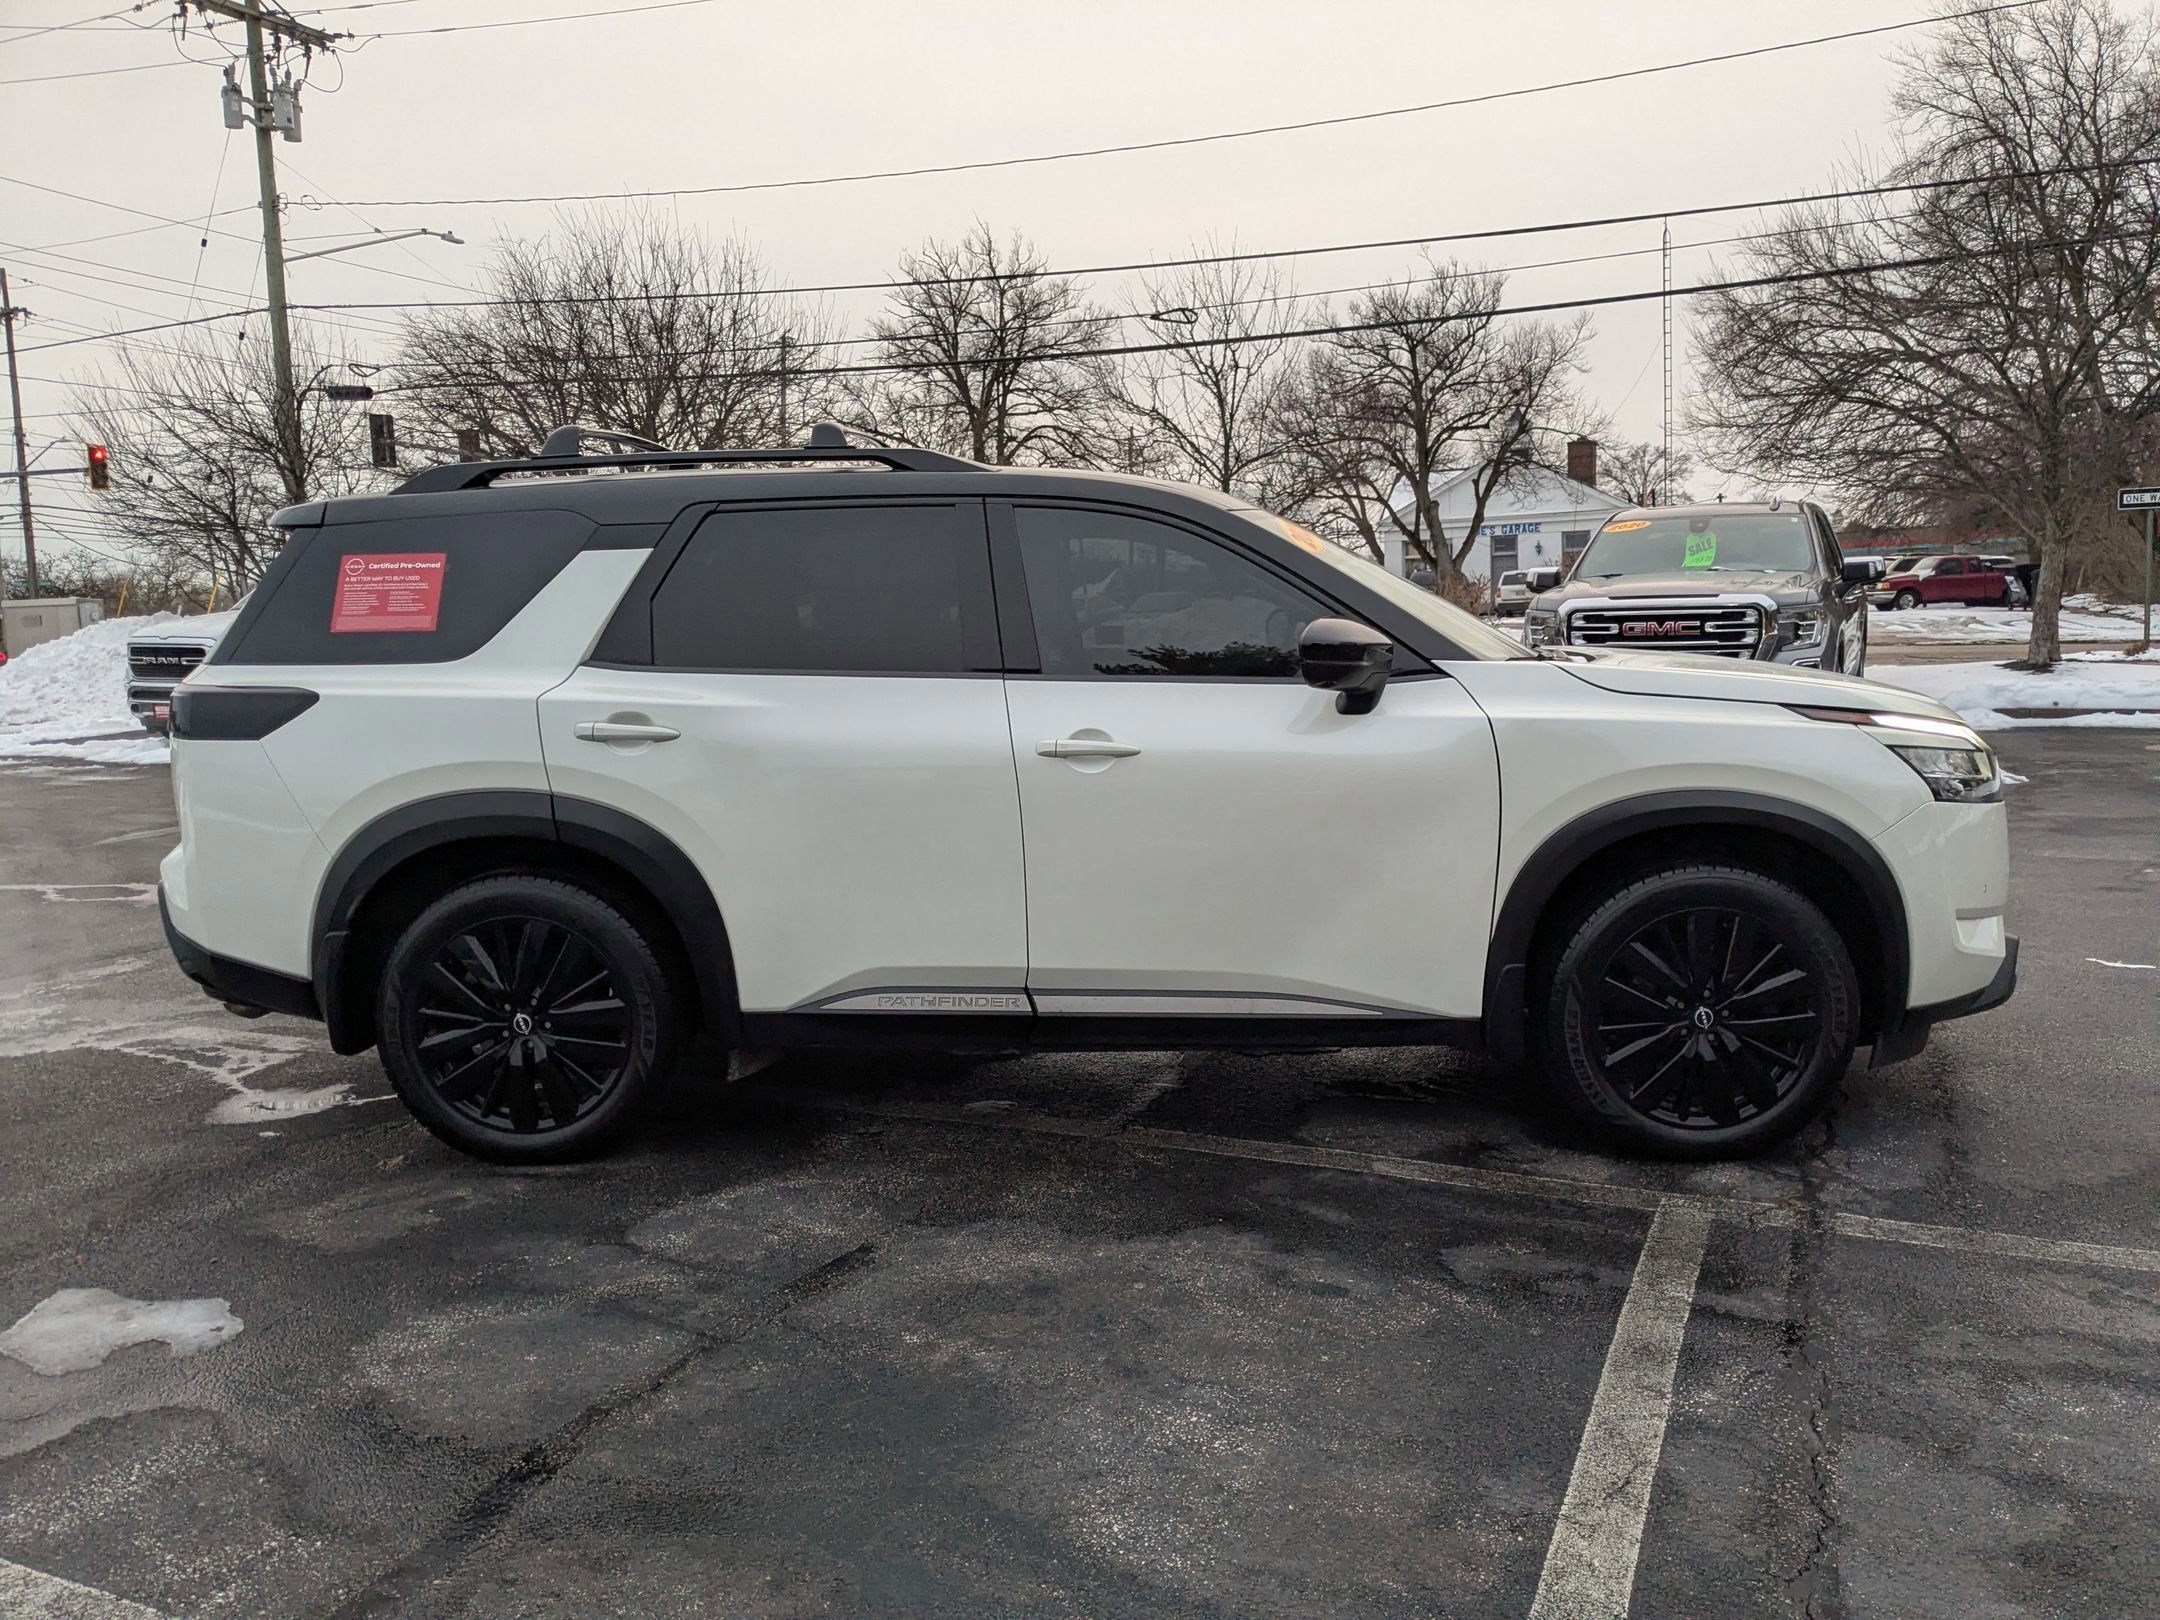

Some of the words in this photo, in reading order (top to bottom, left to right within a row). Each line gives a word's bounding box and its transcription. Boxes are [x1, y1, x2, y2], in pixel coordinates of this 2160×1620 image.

[2125, 494, 2145, 503] ONE
[2150, 493, 2160, 502] W
[1501, 522, 1541, 535] GARAGE
[1610, 521, 1647, 531] 2020
[1688, 538, 1713, 557] SALE
[368, 562, 399, 570] Certified
[400, 561, 441, 569] Pre-Owned
[1622, 621, 1701, 636] GMC
[143, 656, 180, 665] RAM
[877, 996, 1021, 1008] PATHFINDER
